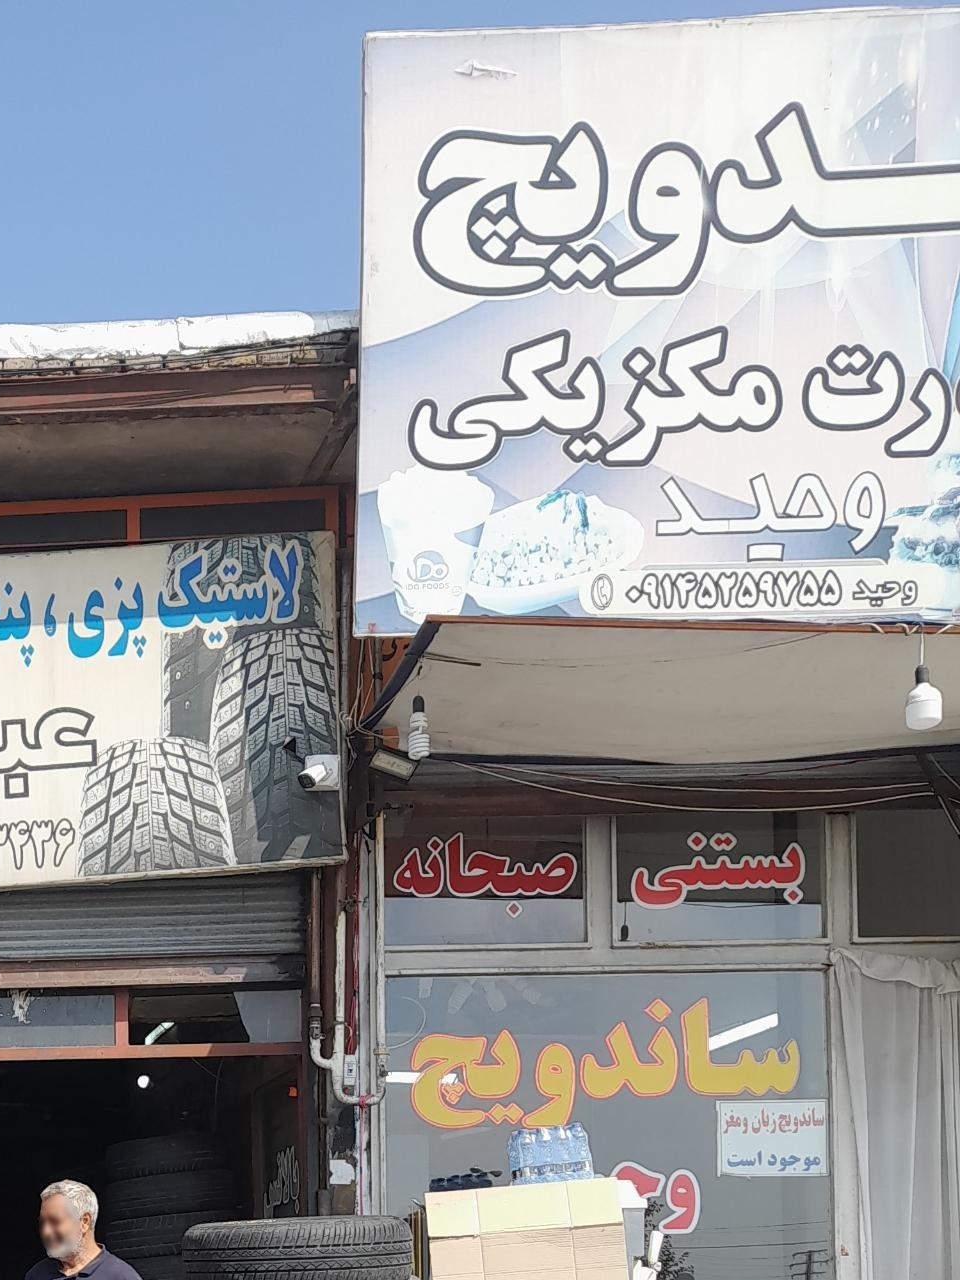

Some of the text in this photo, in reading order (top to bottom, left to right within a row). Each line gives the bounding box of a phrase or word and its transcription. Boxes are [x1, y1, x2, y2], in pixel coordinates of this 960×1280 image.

[413, 101, 960, 297] دویچ
[408, 326, 960, 470] رت مکزیکی
[654, 470, 886, 562] وحید
[156, 540, 304, 648] لاستیک
[852, 578, 919, 607] وحید
[393, 832, 578, 918] صبحانه
[630, 831, 806, 908] بستنی
[410, 997, 801, 1130] ساندویچ
[727, 1149, 821, 1172] موجود است
[751, 1108, 777, 1134] زبان
[778, 1107, 825, 1134] ساندویچ
[608, 1160, 701, 1234] وح
